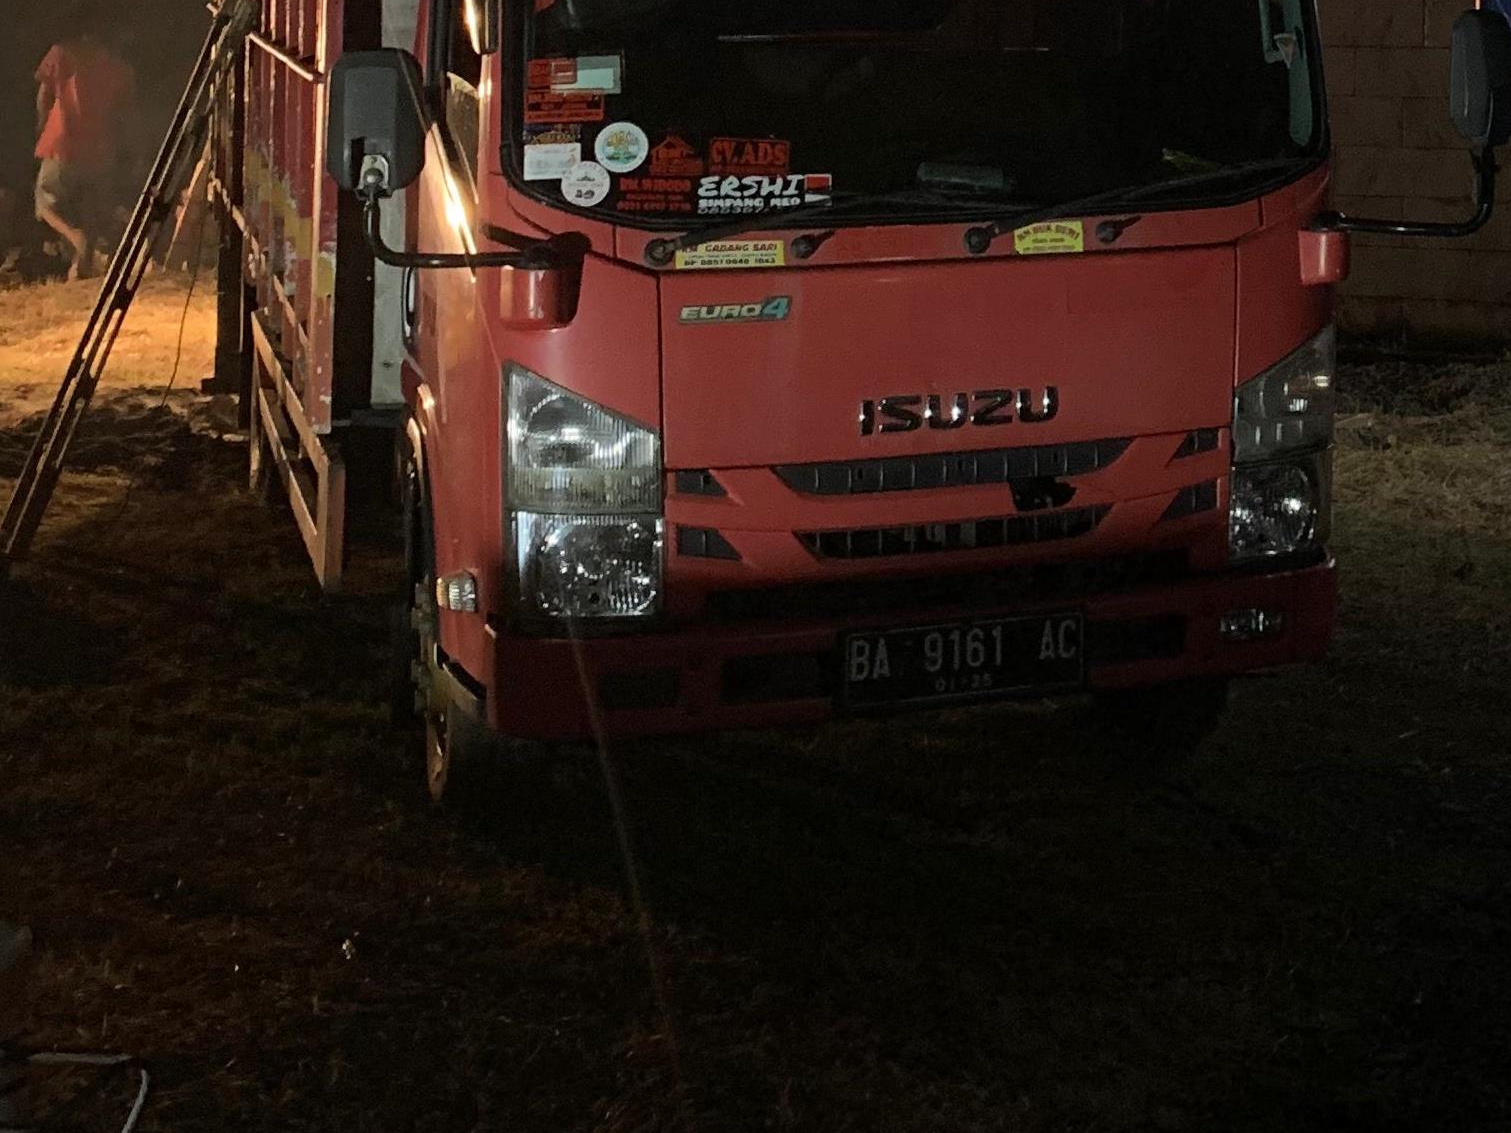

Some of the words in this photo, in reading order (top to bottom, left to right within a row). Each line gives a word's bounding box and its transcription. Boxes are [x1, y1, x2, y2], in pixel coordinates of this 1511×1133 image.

[697, 174, 804, 198] ERSHI
[859, 385, 1059, 436] ISUZU
[850, 638, 891, 683] BA
[924, 624, 1004, 673] 9161
[1038, 618, 1077, 660] AC
